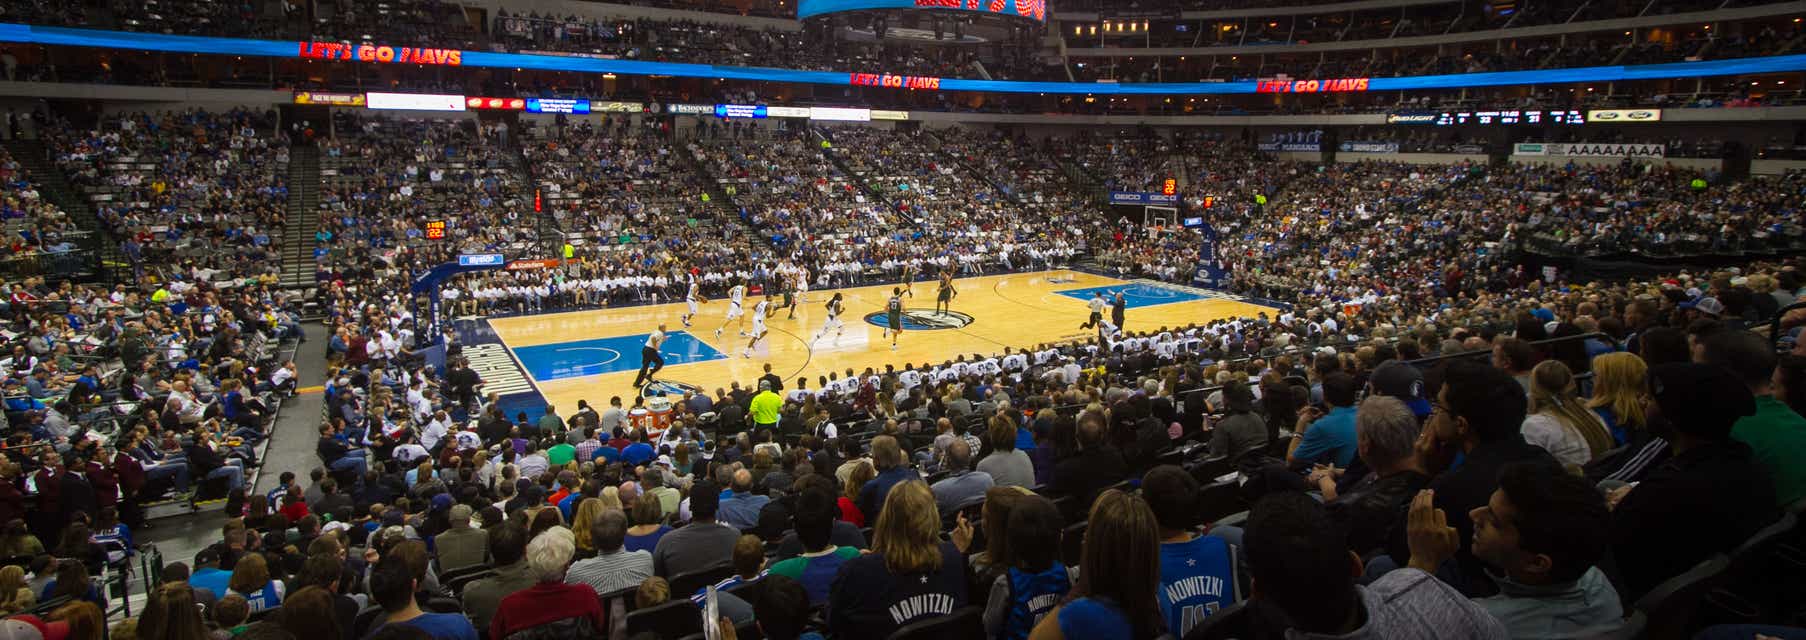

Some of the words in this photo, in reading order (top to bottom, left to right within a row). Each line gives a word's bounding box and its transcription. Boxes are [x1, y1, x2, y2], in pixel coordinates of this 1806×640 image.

[299, 42, 351, 60] LET'S
[358, 45, 395, 62] GO
[850, 73, 879, 85] LET'S
[882, 75, 902, 87] GO
[1257, 81, 1291, 93] LET'S
[1294, 80, 1319, 92] GO
[429, 228, 441, 237] 22
[1166, 576, 1223, 604] NOWITZKI
[889, 593, 954, 624] NOWITZKI
[1027, 593, 1056, 612] NOWITZ
